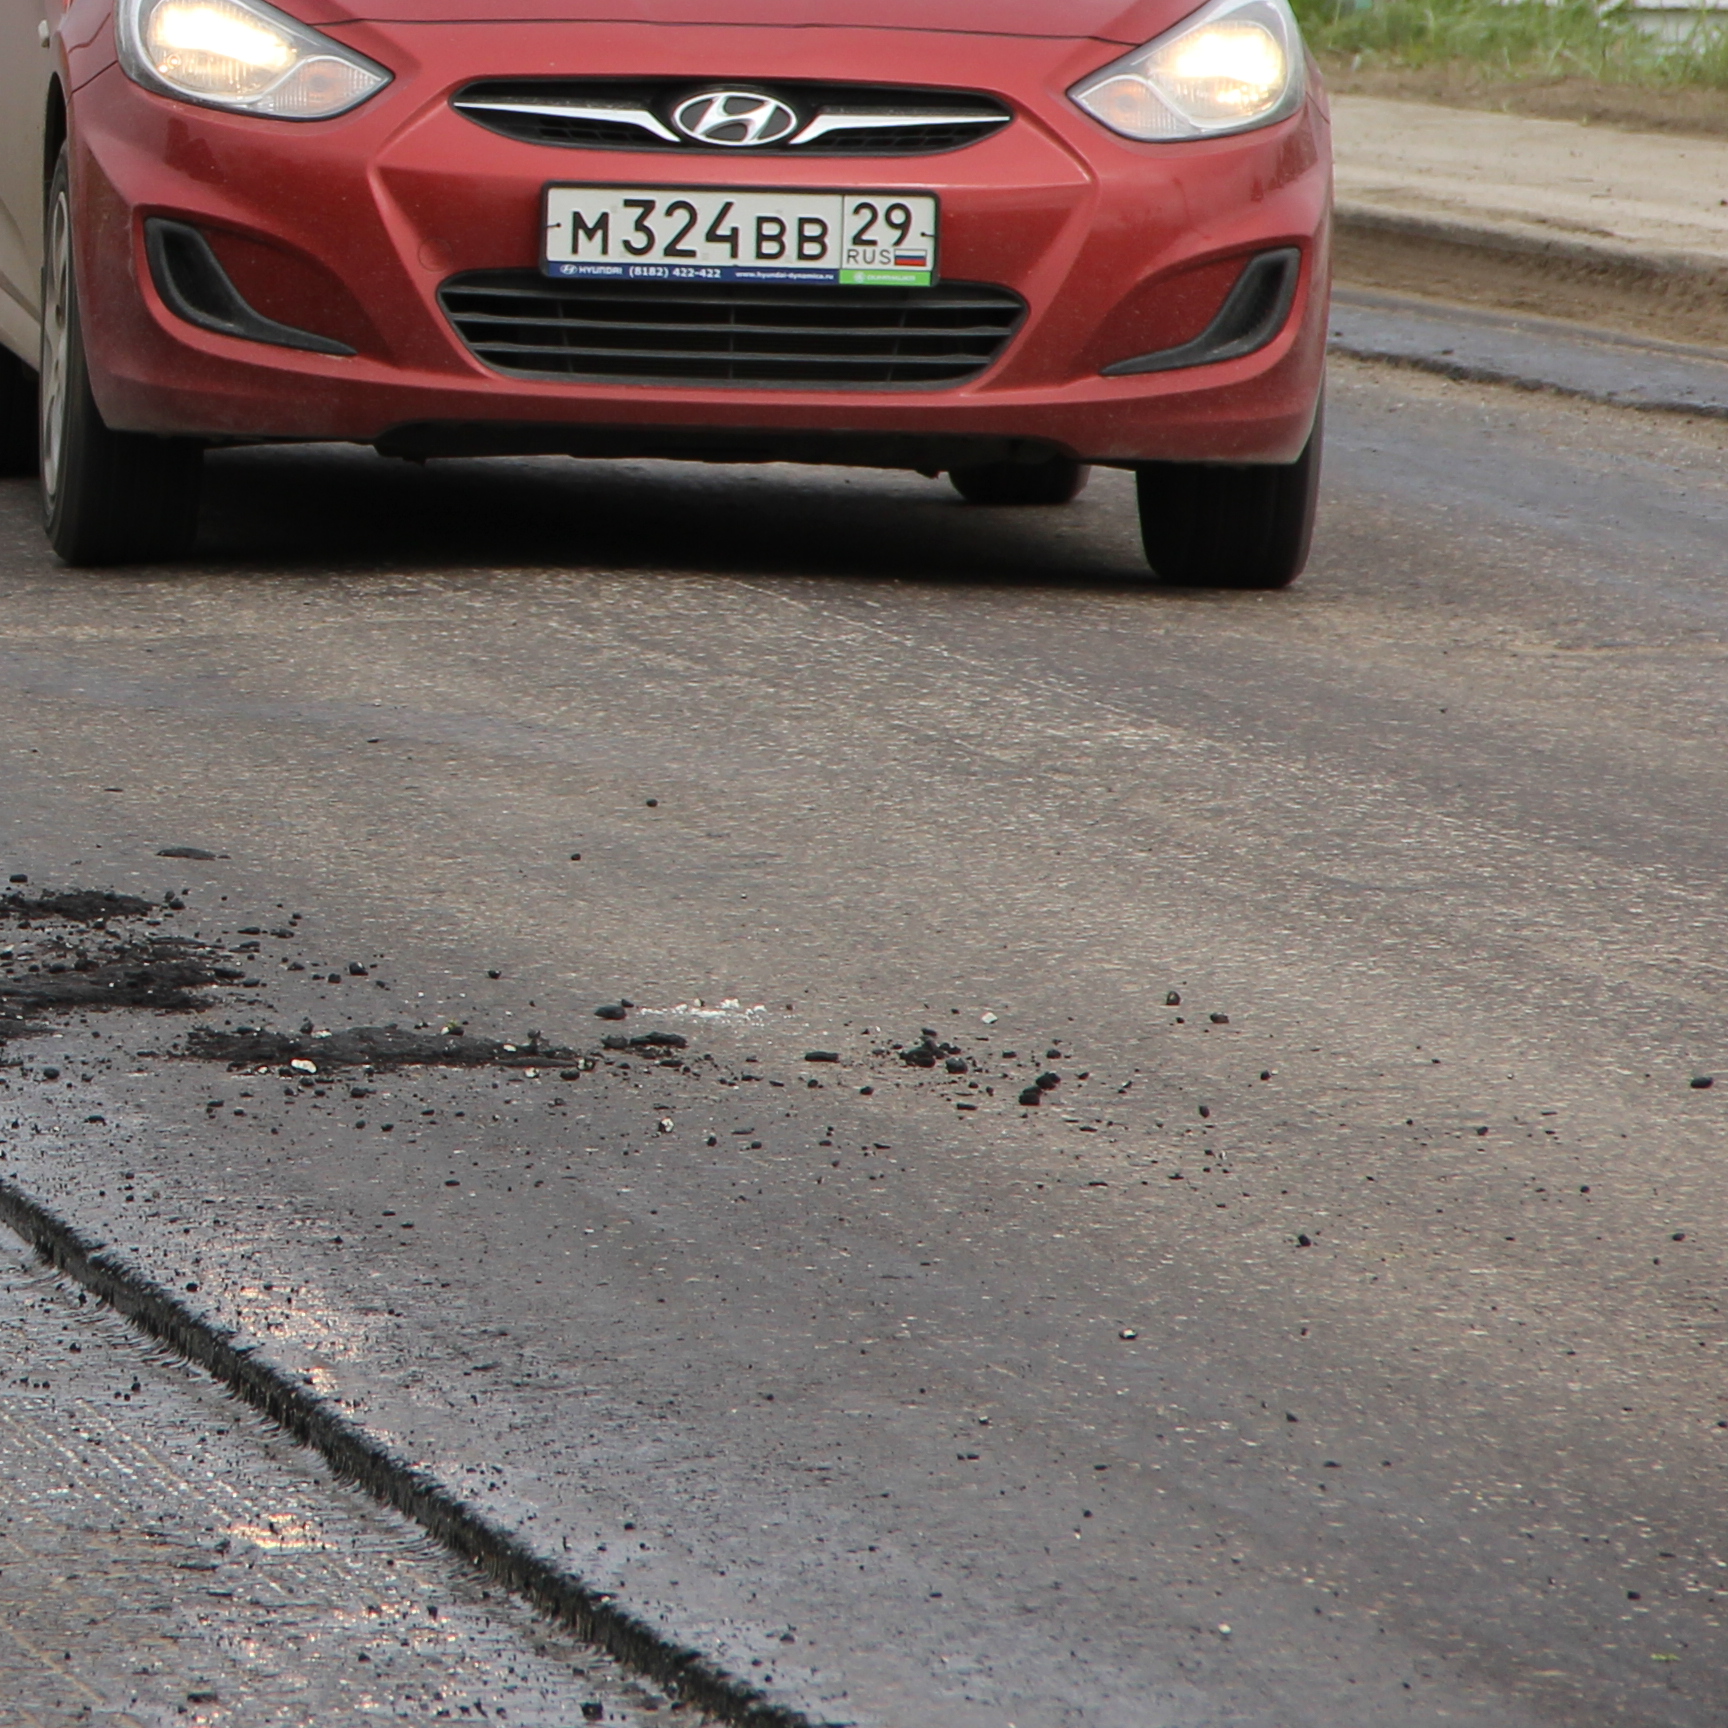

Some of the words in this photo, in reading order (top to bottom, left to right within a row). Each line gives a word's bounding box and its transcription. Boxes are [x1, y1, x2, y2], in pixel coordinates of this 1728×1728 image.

[571, 198, 829, 261] М324ВВ
[852, 201, 913, 247] 29
[846, 248, 892, 265] RUS
[578, 266, 623, 276] HYUNDAI
[629, 265, 669, 278] (8182)
[672, 267, 722, 279] 422-422
